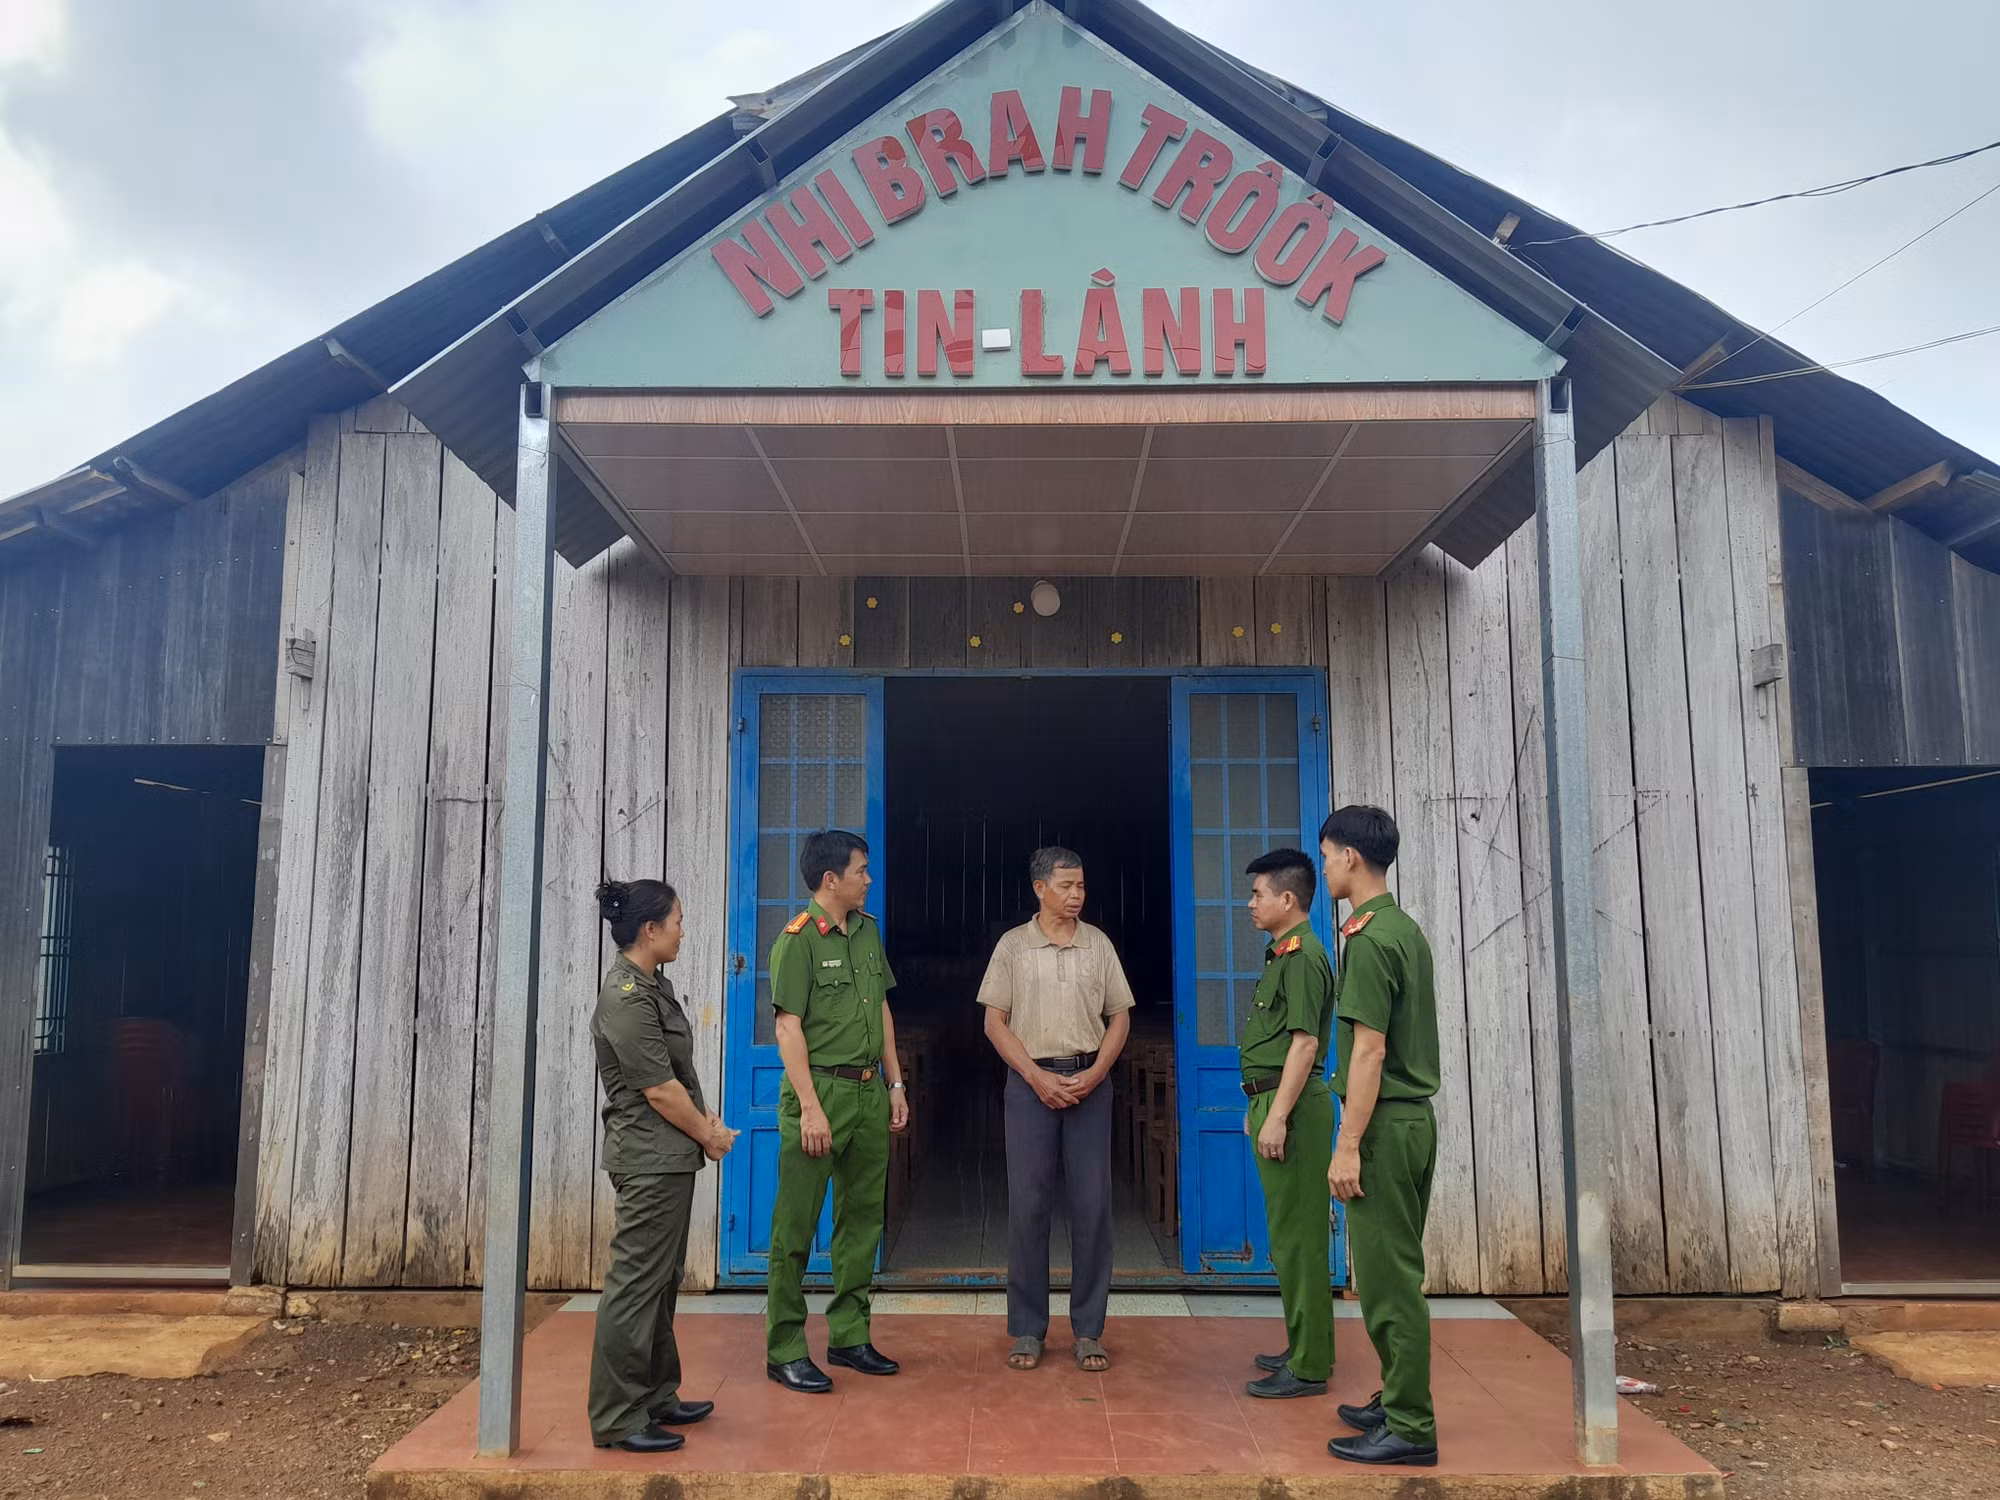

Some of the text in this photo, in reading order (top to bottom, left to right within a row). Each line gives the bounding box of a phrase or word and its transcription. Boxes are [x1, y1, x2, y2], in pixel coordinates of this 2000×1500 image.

[710, 85, 1389, 325] NHI BRAH TRÔÔK
